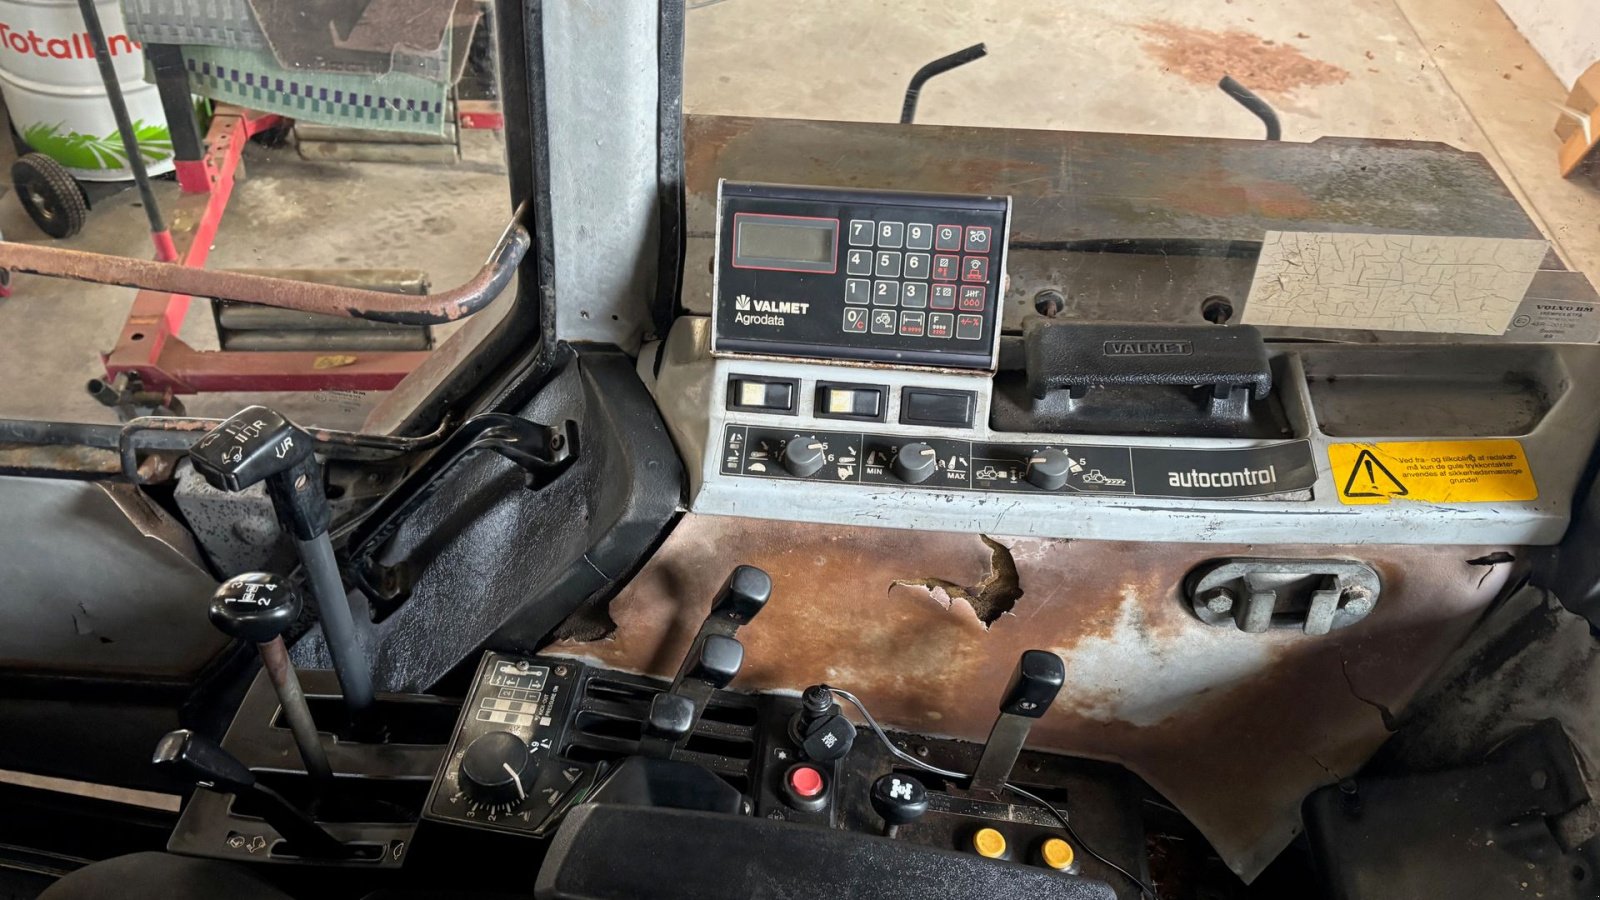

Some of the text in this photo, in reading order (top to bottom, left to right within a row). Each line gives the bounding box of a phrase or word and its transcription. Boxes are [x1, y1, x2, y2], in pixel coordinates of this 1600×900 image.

[854, 224, 862, 235] 7
[882, 225, 892, 237] 8
[911, 227, 921, 239] 9
[851, 253, 860, 264] 4
[880, 255, 889, 266] 5
[909, 256, 919, 268] 6
[850, 282, 856, 294] 1
[878, 284, 887, 295] 2
[906, 285, 916, 297] 3
[753, 300, 810, 314] VALMET
[734, 312, 785, 326] Agrodata
[1112, 343, 1185, 353] VALMET
[822, 442, 829, 450] 5
[891, 446, 898, 454] 5
[1062, 448, 1069, 456] 4
[827, 454, 835, 462] 6
[1079, 458, 1087, 466] 5
[1443, 454, 1476, 463] tilkobling
[1465, 461, 1513, 470] trykkontakter
[866, 467, 883, 475] MIN
[947, 472, 966, 480] MAX
[1168, 464, 1277, 488] autocontrol
[231, 581, 244, 589] 3
[265, 583, 278, 591] 4
[257, 597, 272, 606] 2
[544, 693, 557, 717] PRESSURE
